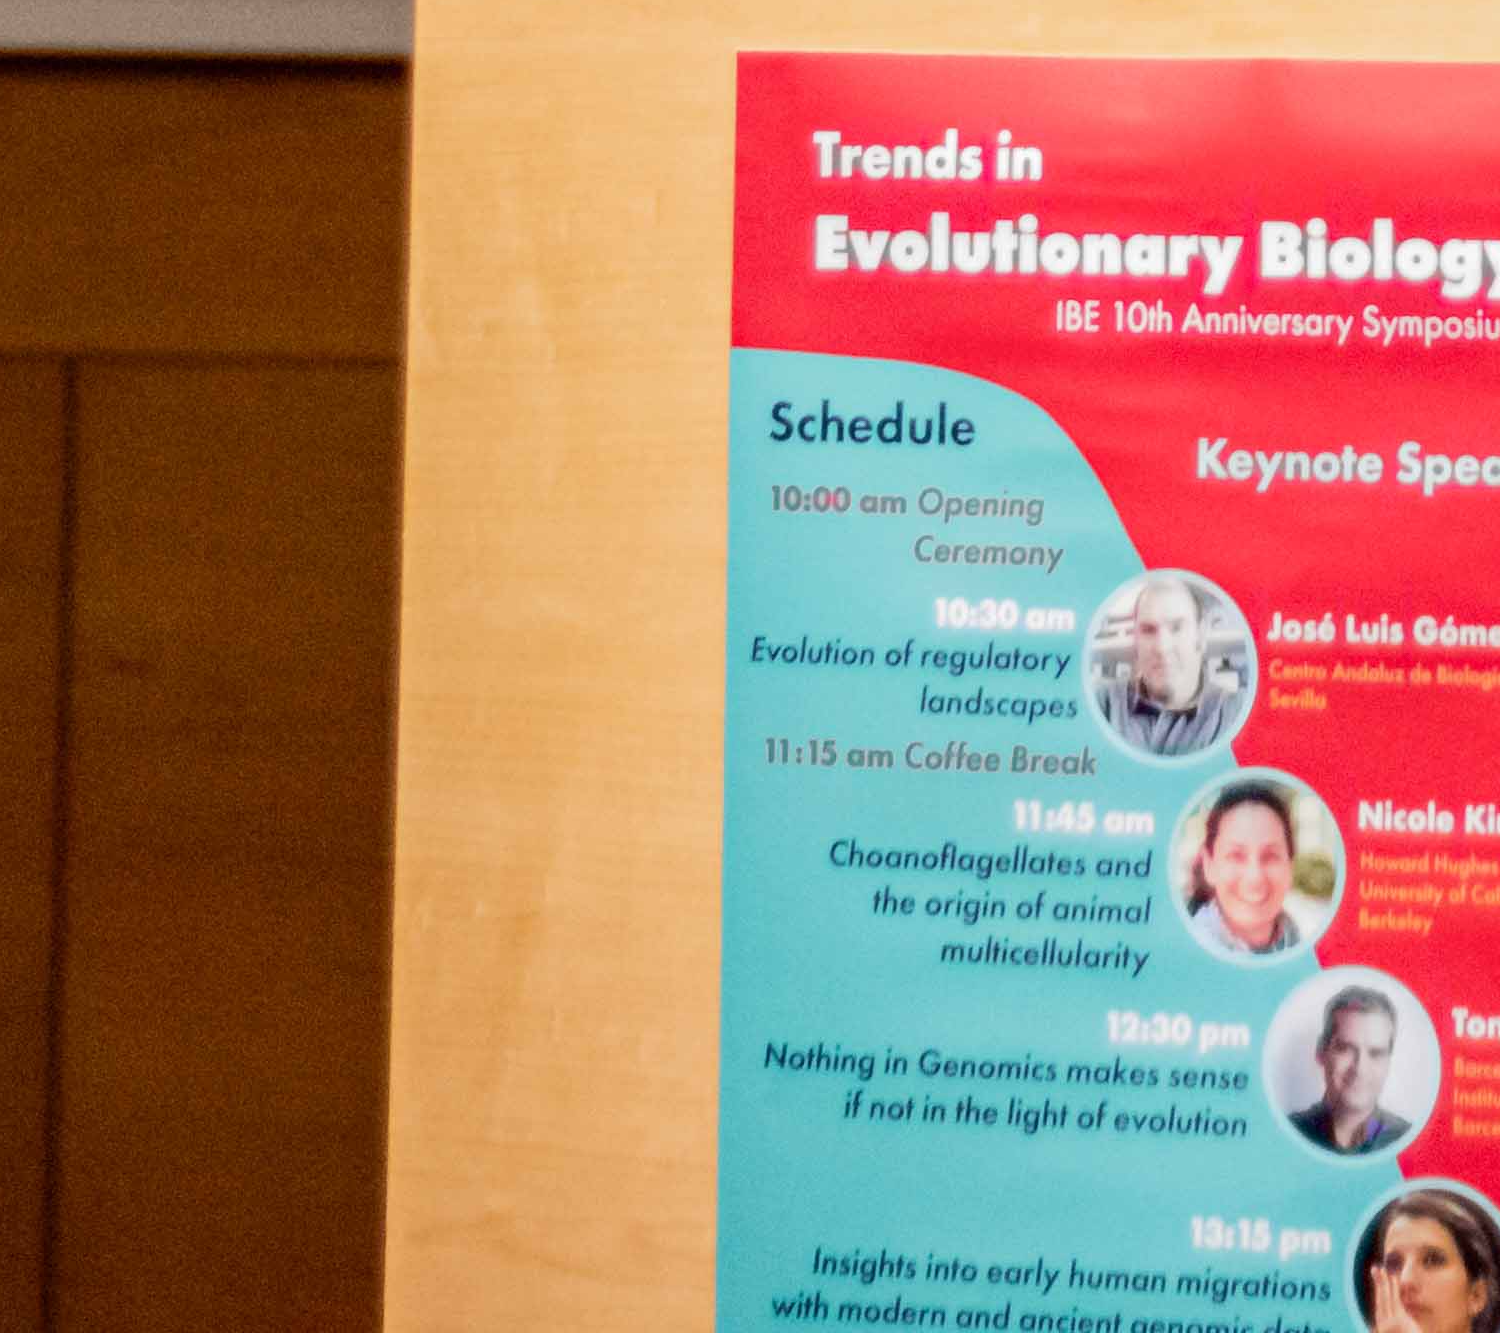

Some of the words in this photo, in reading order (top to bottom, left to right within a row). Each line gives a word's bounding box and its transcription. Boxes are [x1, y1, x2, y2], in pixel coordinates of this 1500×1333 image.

[814, 129, 982, 181] Trends
[997, 130, 1042, 181] in
[815, 212, 1242, 294] Evolutionary
[1056, 301, 1099, 332] IBE
[1114, 301, 1172, 334] 10th
[1182, 304, 1353, 344] Anniversary
[770, 400, 975, 445] Schedule
[1196, 437, 1383, 493] Keynote
[772, 485, 851, 513] 10:00
[859, 493, 907, 514] am
[918, 487, 1045, 526] Opening
[914, 536, 1064, 573] Ceremony
[934, 596, 1018, 628] 10:30
[1025, 608, 1075, 631] am
[1267, 612, 1336, 642] José
[1346, 613, 1404, 645] Luis
[751, 636, 875, 666] Evolution
[884, 639, 915, 667] of
[921, 643, 1071, 678] regulatory
[1269, 658, 1327, 680] Centro
[1409, 661, 1432, 683] de
[920, 685, 1078, 724] landscapes
[1269, 688, 1327, 709] Sevilla
[766, 738, 837, 767] 11:15
[847, 748, 893, 768] am
[905, 741, 1000, 771] Coffee
[1011, 746, 1096, 776] Break
[1014, 799, 1095, 833] 11:45
[1104, 811, 1155, 835] am
[1358, 800, 1454, 832] Nicole
[829, 840, 1085, 879] Choanoflagellates
[1096, 851, 1152, 878] and
[1360, 852, 1430, 874] Howard
[1435, 854, 1499, 881] Hughes
[872, 885, 915, 914] the
[925, 889, 1005, 924] origin
[1016, 891, 1046, 920] of
[1053, 898, 1151, 924] animal
[1360, 881, 1444, 906] University
[1449, 885, 1466, 904] of
[1359, 907, 1433, 936] Berkeley
[940, 935, 1150, 977] multicellularity
[1106, 1011, 1194, 1045] 12:30
[1200, 1023, 1251, 1053] pm
[764, 1042, 875, 1080] Nothing
[884, 1049, 908, 1074] in
[918, 1049, 1057, 1083] Genomics
[1067, 1056, 1159, 1086] makes
[1169, 1066, 1248, 1090] sense
[844, 1091, 863, 1120] if
[870, 1097, 914, 1122] not
[922, 1097, 946, 1123] in
[956, 1097, 998, 1125] the
[1008, 1099, 1068, 1135] light
[1077, 1101, 1107, 1130] of
[1114, 1106, 1248, 1137] evolution
[1191, 1214, 1272, 1253] 13:15
[1278, 1228, 1332, 1261] pm
[813, 1247, 916, 1285] Insights
[926, 1253, 978, 1283] into
[987, 1259, 1059, 1295] early
[1069, 1259, 1166, 1294] human
[1176, 1268, 1332, 1304] migrations
[772, 1290, 829, 1320] with
[837, 1296, 946, 1325] modern
[956, 1302, 1011, 1329] and
[1019, 1302, 1124, 1333] ancient
[1132, 1309, 1250, 1333] genomic
